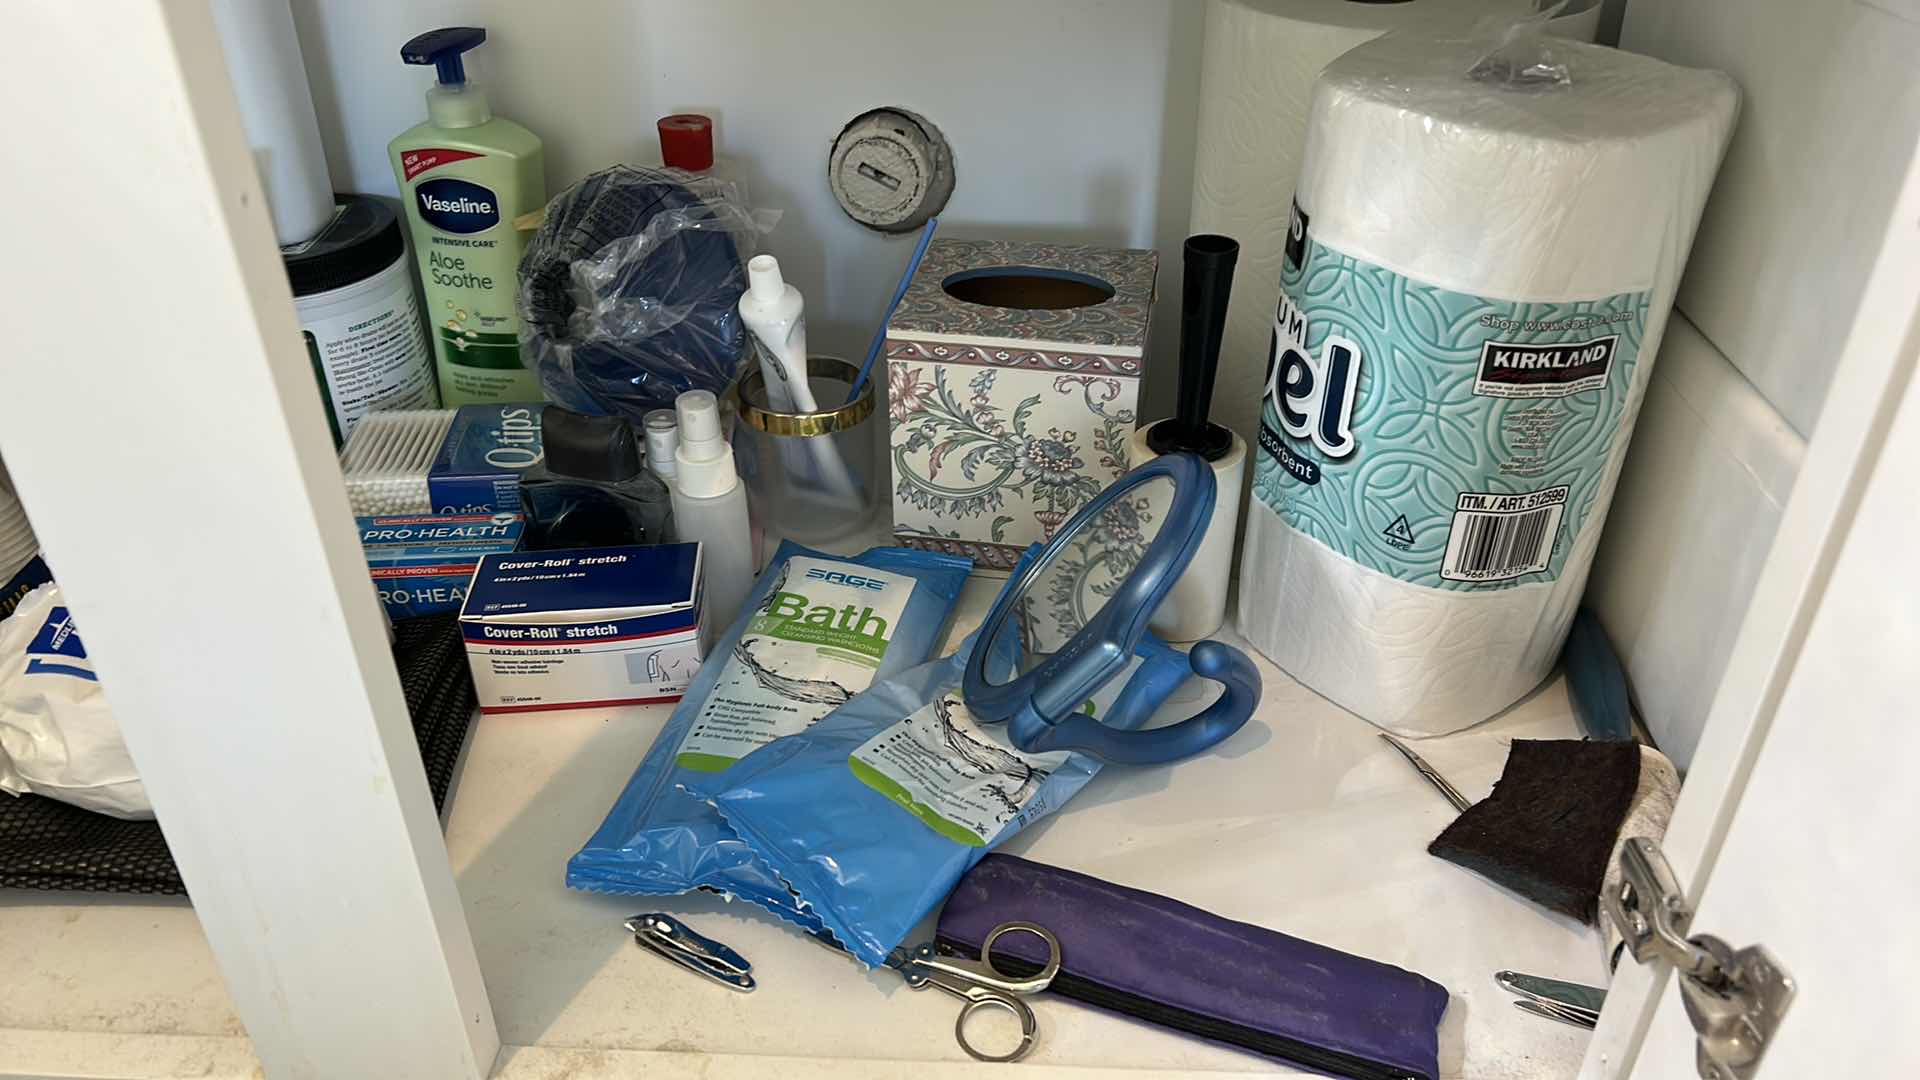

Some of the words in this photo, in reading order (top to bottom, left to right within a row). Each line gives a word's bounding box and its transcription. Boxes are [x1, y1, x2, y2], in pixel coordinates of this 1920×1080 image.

[421, 193, 492, 214] Vaseline
[432, 236, 471, 248] INTENSIVE
[429, 250, 465, 271] Aloe
[431, 267, 494, 290] Soothe
[1276, 296, 1304, 344] UM
[1480, 313, 1519, 333] Shop
[1493, 344, 1607, 369] KIRKLAND
[1268, 344, 1352, 448] el
[1261, 426, 1313, 480] bsorbent
[440, 503, 492, 514] Qtips
[1527, 488, 1566, 509] 512599
[499, 558, 571, 571] Cover-Roll
[578, 555, 627, 566] stretch
[805, 568, 887, 591] SAGE
[1465, 569, 1497, 579] 96619
[378, 586, 469, 605] RO·HEA
[767, 591, 888, 639] Bath
[51, 621, 75, 651] MEDLI
[484, 626, 558, 639] Cover-Roll
[566, 624, 618, 638] stretch
